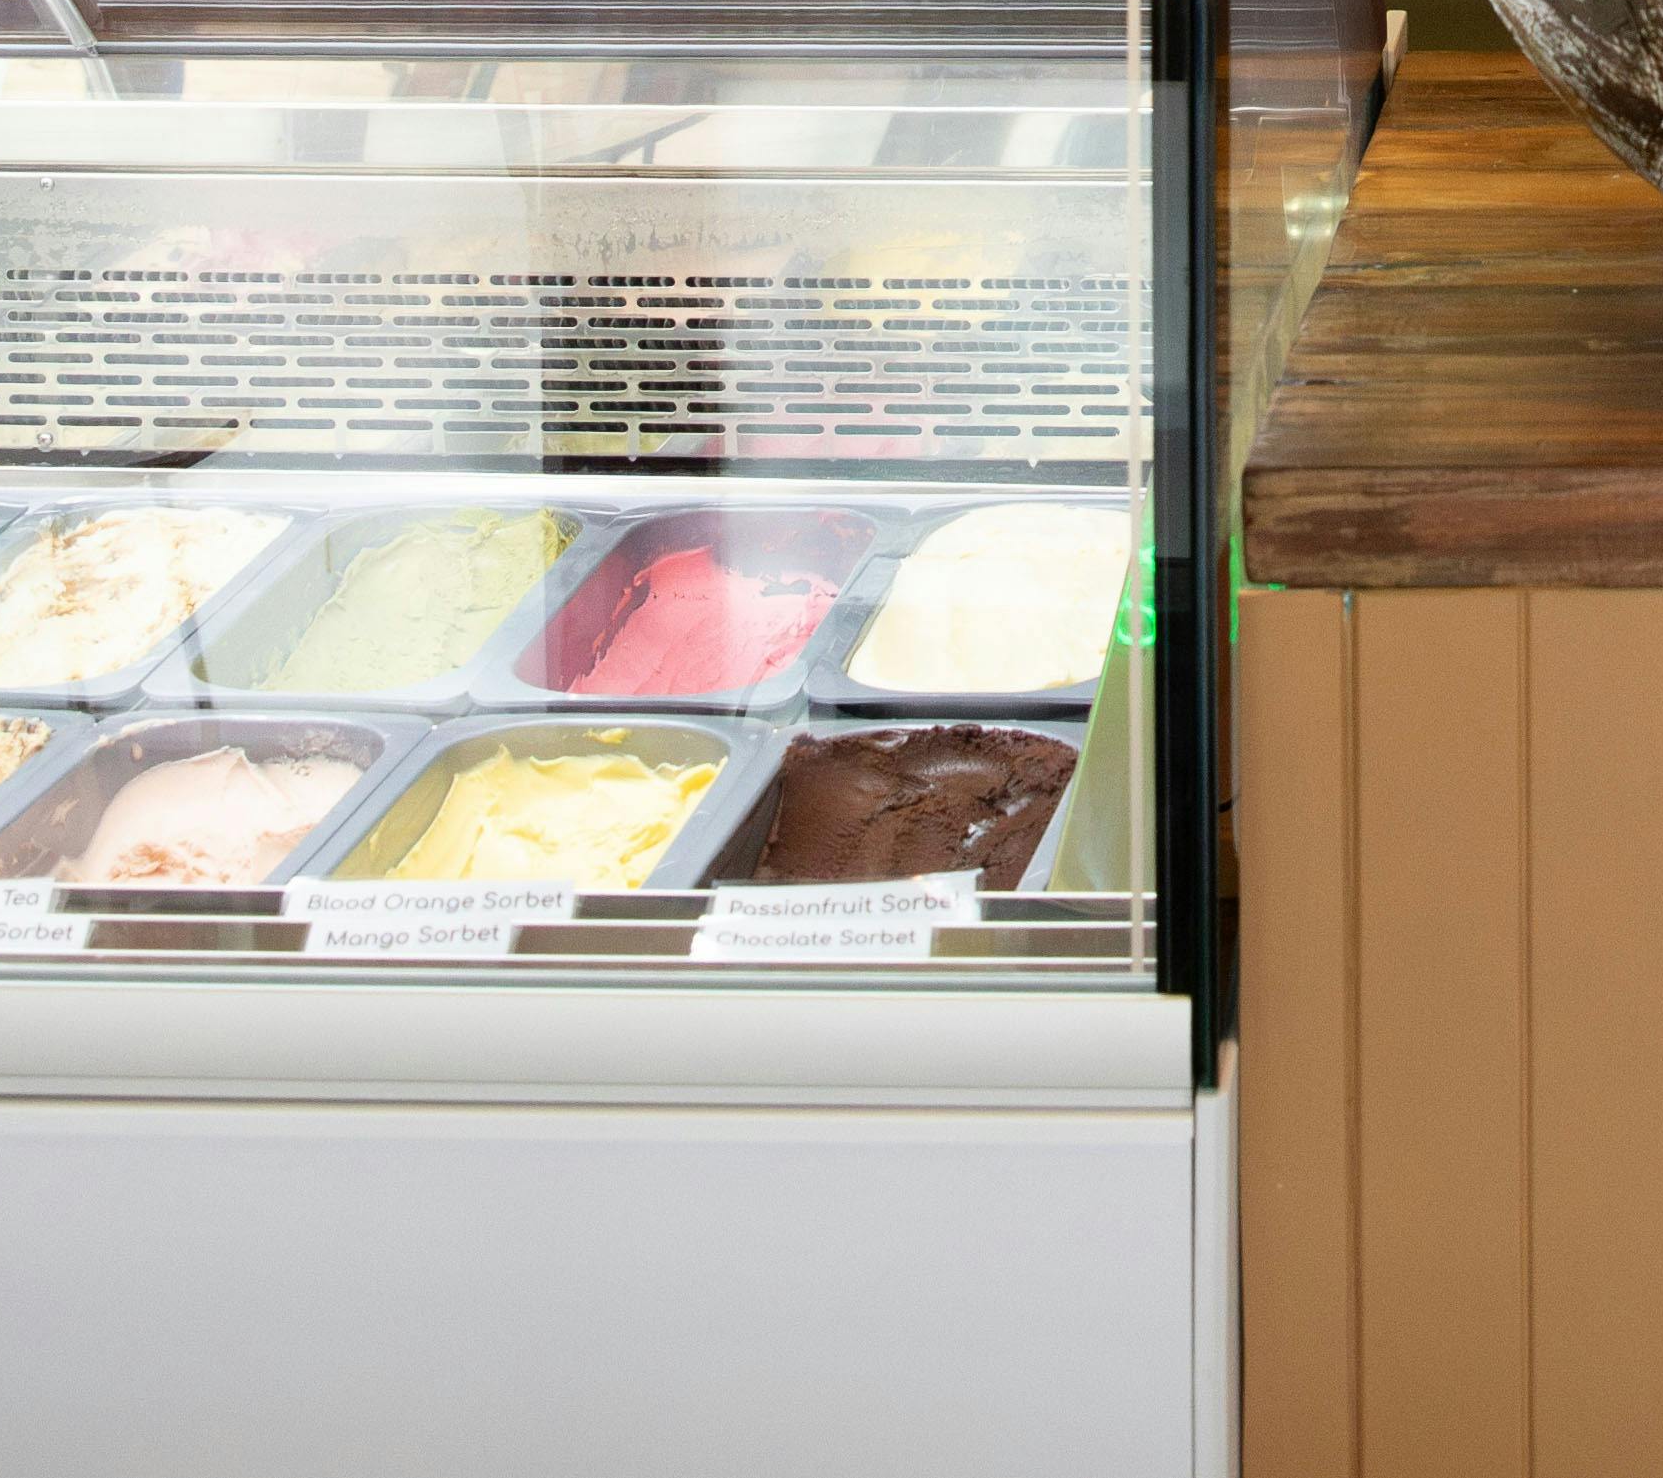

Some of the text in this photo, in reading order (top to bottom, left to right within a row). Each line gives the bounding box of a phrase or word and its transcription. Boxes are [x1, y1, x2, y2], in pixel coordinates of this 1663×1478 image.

[2, 888, 40, 907] Tea
[306, 890, 564, 914] Blood Orange Sorbet
[728, 896, 873, 917] Passionfruit
[325, 923, 501, 950] Mango Sorbet
[714, 927, 917, 948] Chocolate Sorbet
